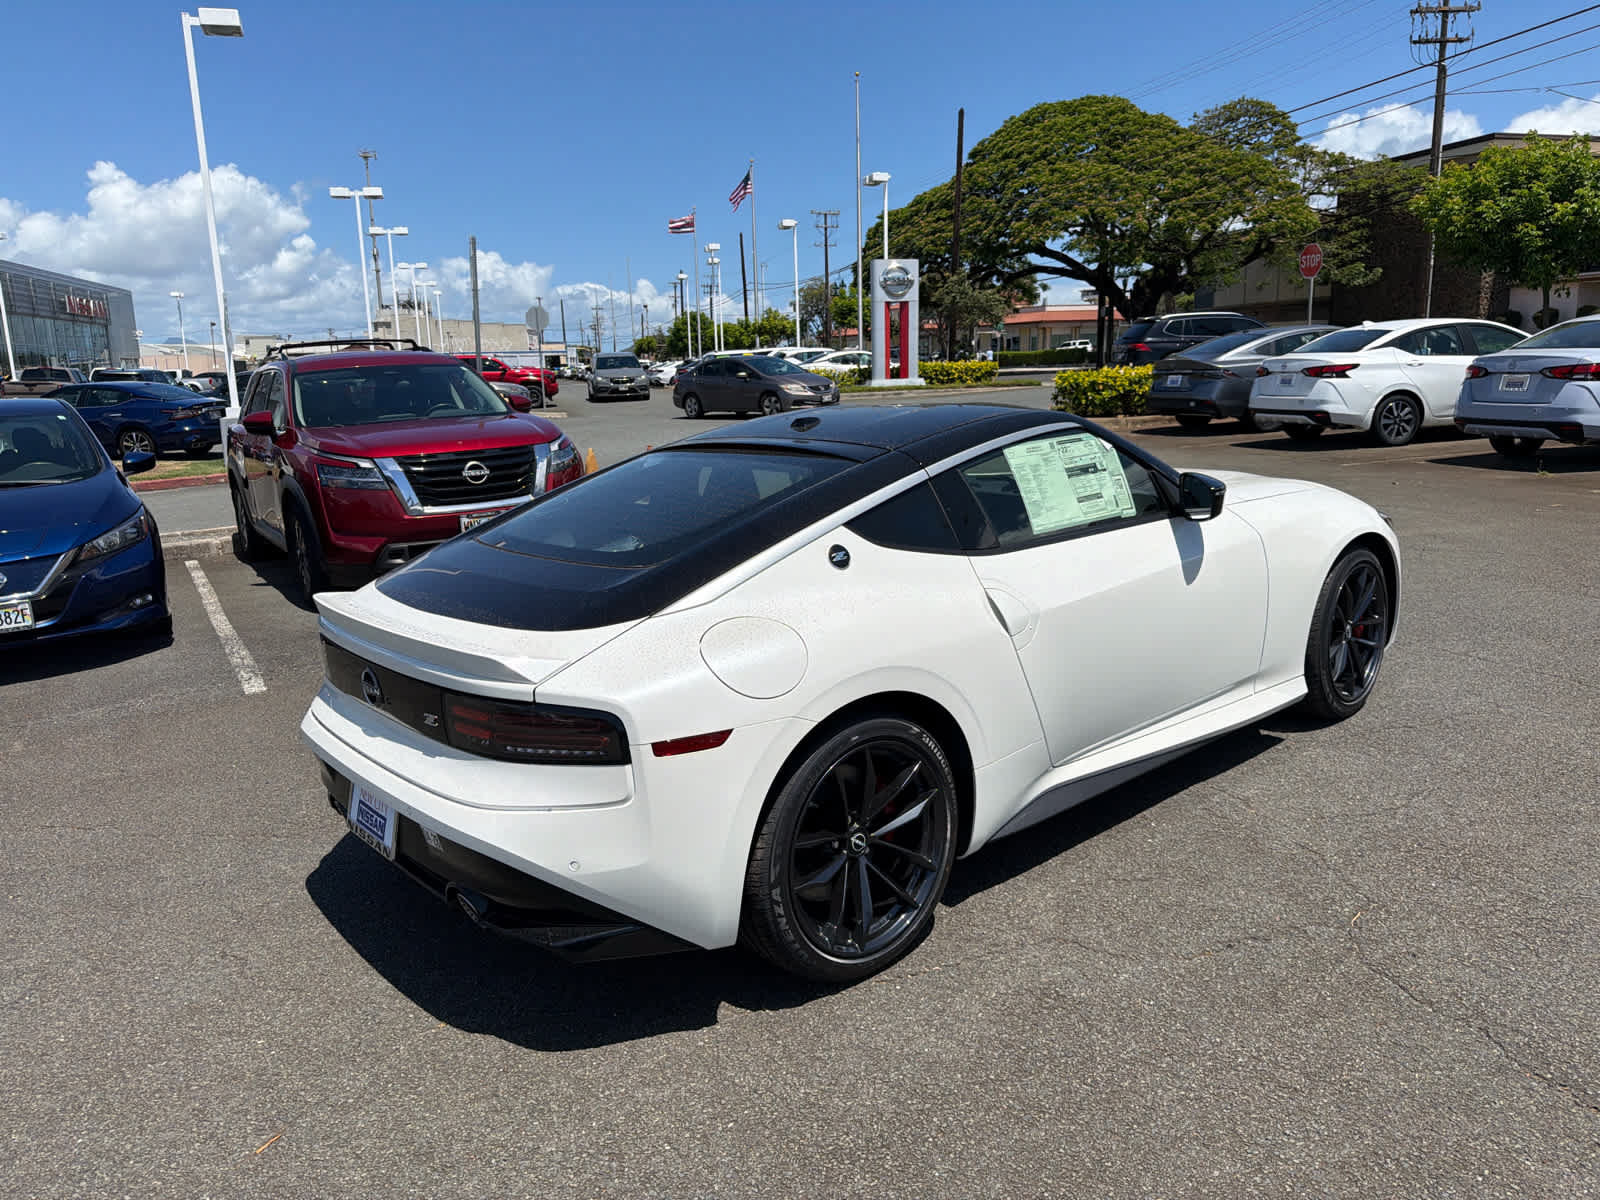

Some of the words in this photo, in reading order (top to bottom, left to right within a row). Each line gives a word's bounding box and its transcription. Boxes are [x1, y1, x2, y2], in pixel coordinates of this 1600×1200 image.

[1301, 254, 1321, 268] STOP
[65, 295, 107, 318] NISSAN
[359, 805, 386, 837] NISSAN
[349, 819, 392, 858] NISSAN
